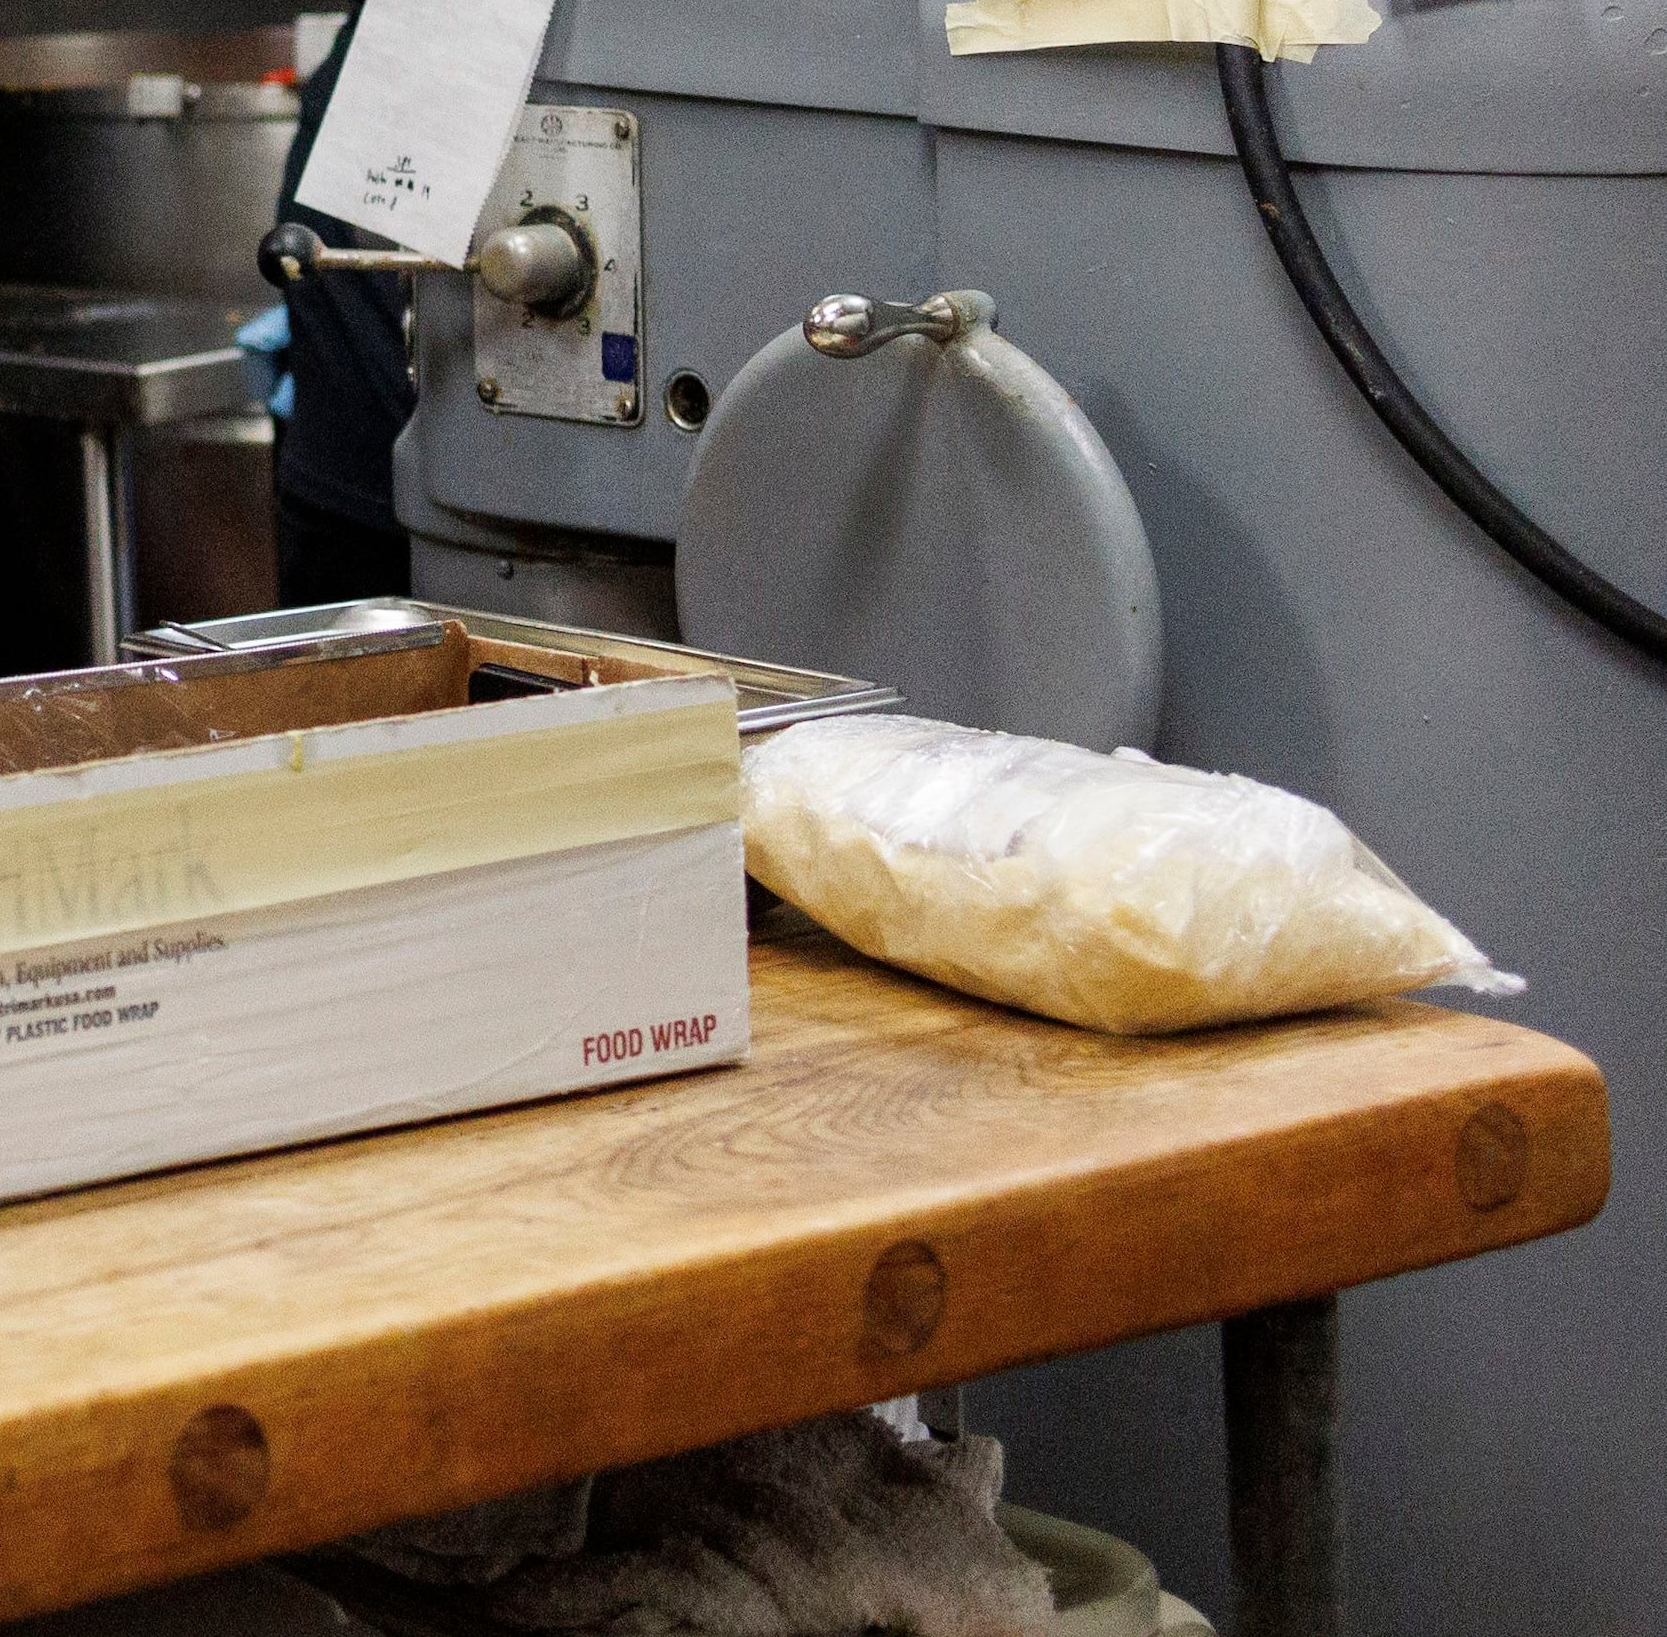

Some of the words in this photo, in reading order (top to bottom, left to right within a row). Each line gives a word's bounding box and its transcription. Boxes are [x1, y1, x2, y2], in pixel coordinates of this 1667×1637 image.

[520, 189, 534, 207] 2
[575, 193, 589, 212] 3
[15, 950, 112, 988] Equipment
[117, 940, 149, 968] and
[5, 1016, 68, 1045] PLASTIC
[72, 1009, 113, 1034] FOOD
[116, 1001, 159, 1024] WRAP
[582, 1027, 643, 1066] FOOD
[649, 1013, 717, 1052] WRAP
